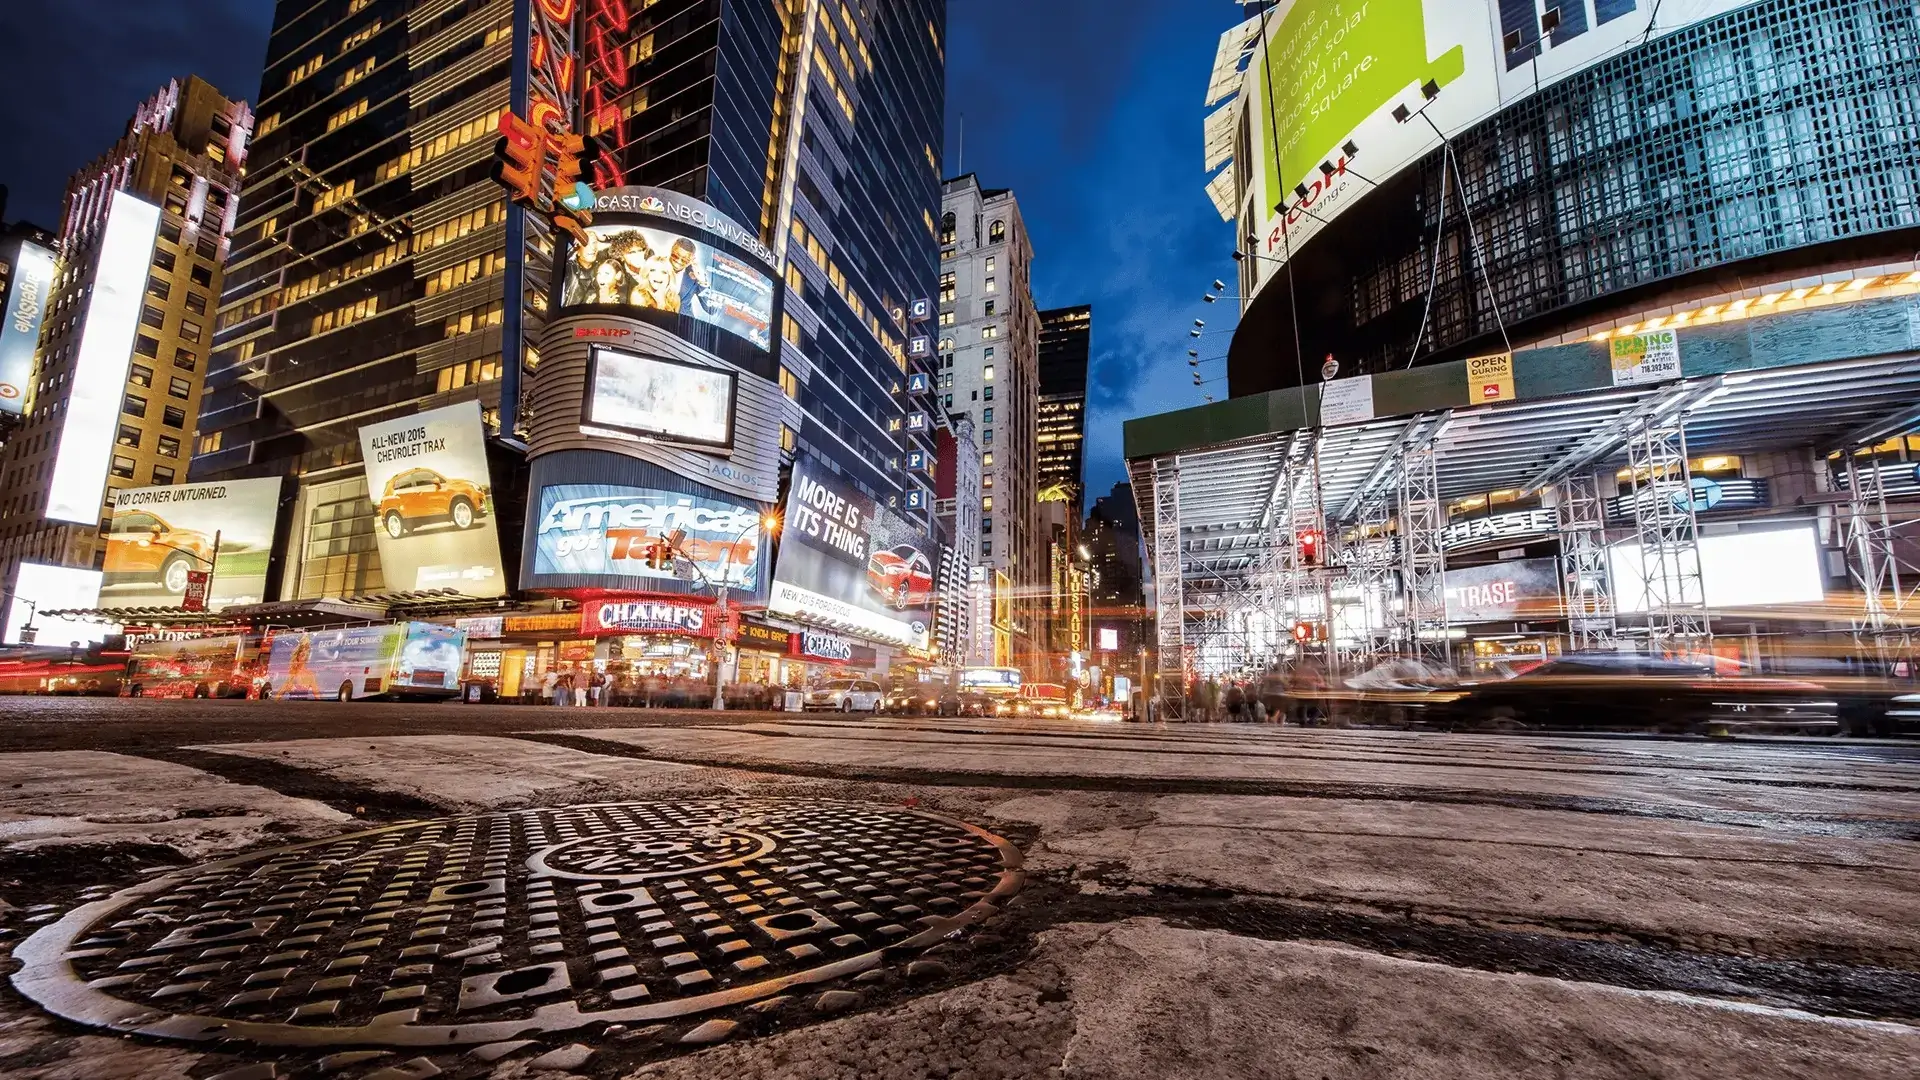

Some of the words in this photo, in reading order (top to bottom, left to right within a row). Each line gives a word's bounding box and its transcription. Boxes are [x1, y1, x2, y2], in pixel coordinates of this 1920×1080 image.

[1271, 10, 1316, 76] magine
[1290, 53, 1320, 97] only
[1325, 1, 1369, 55] solar
[1332, 50, 1348, 73] in
[1310, 55, 1378, 123] square.
[1268, 156, 1345, 253] RICOH
[1305, 181, 1350, 223] change.
[592, 194, 640, 210] CAST
[666, 201, 780, 269] NBCUNIVERSAL
[575, 327, 631, 339] SHARP
[1615, 332, 1673, 351] SPRING
[1471, 356, 1507, 368] OPEN
[1472, 365, 1507, 375] DURING
[910, 302, 926, 508] CHAMPS
[371, 430, 406, 449] ALL-NEW
[407, 426, 426, 440] 2015
[377, 443, 421, 463] CHEVROLET
[424, 438, 446, 454] TRAX
[711, 463, 758, 486] AQUOS
[117, 492, 130, 506] NO
[132, 490, 170, 505] CORNER
[173, 486, 227, 502] UNTURNED.
[797, 475, 845, 520] MORE
[844, 503, 860, 529] IS
[793, 504, 823, 537] ITS
[823, 518, 865, 560] THING.
[1434, 508, 1553, 546] CHASE
[555, 531, 602, 557] got
[780, 588, 799, 601] NEW
[598, 603, 703, 630] CHAMPS
[975, 583, 984, 658] AMSTERDAM
[749, 627, 768, 639] KNOW
[771, 631, 788, 643] GAME
[808, 634, 851, 660] CHAMPS
